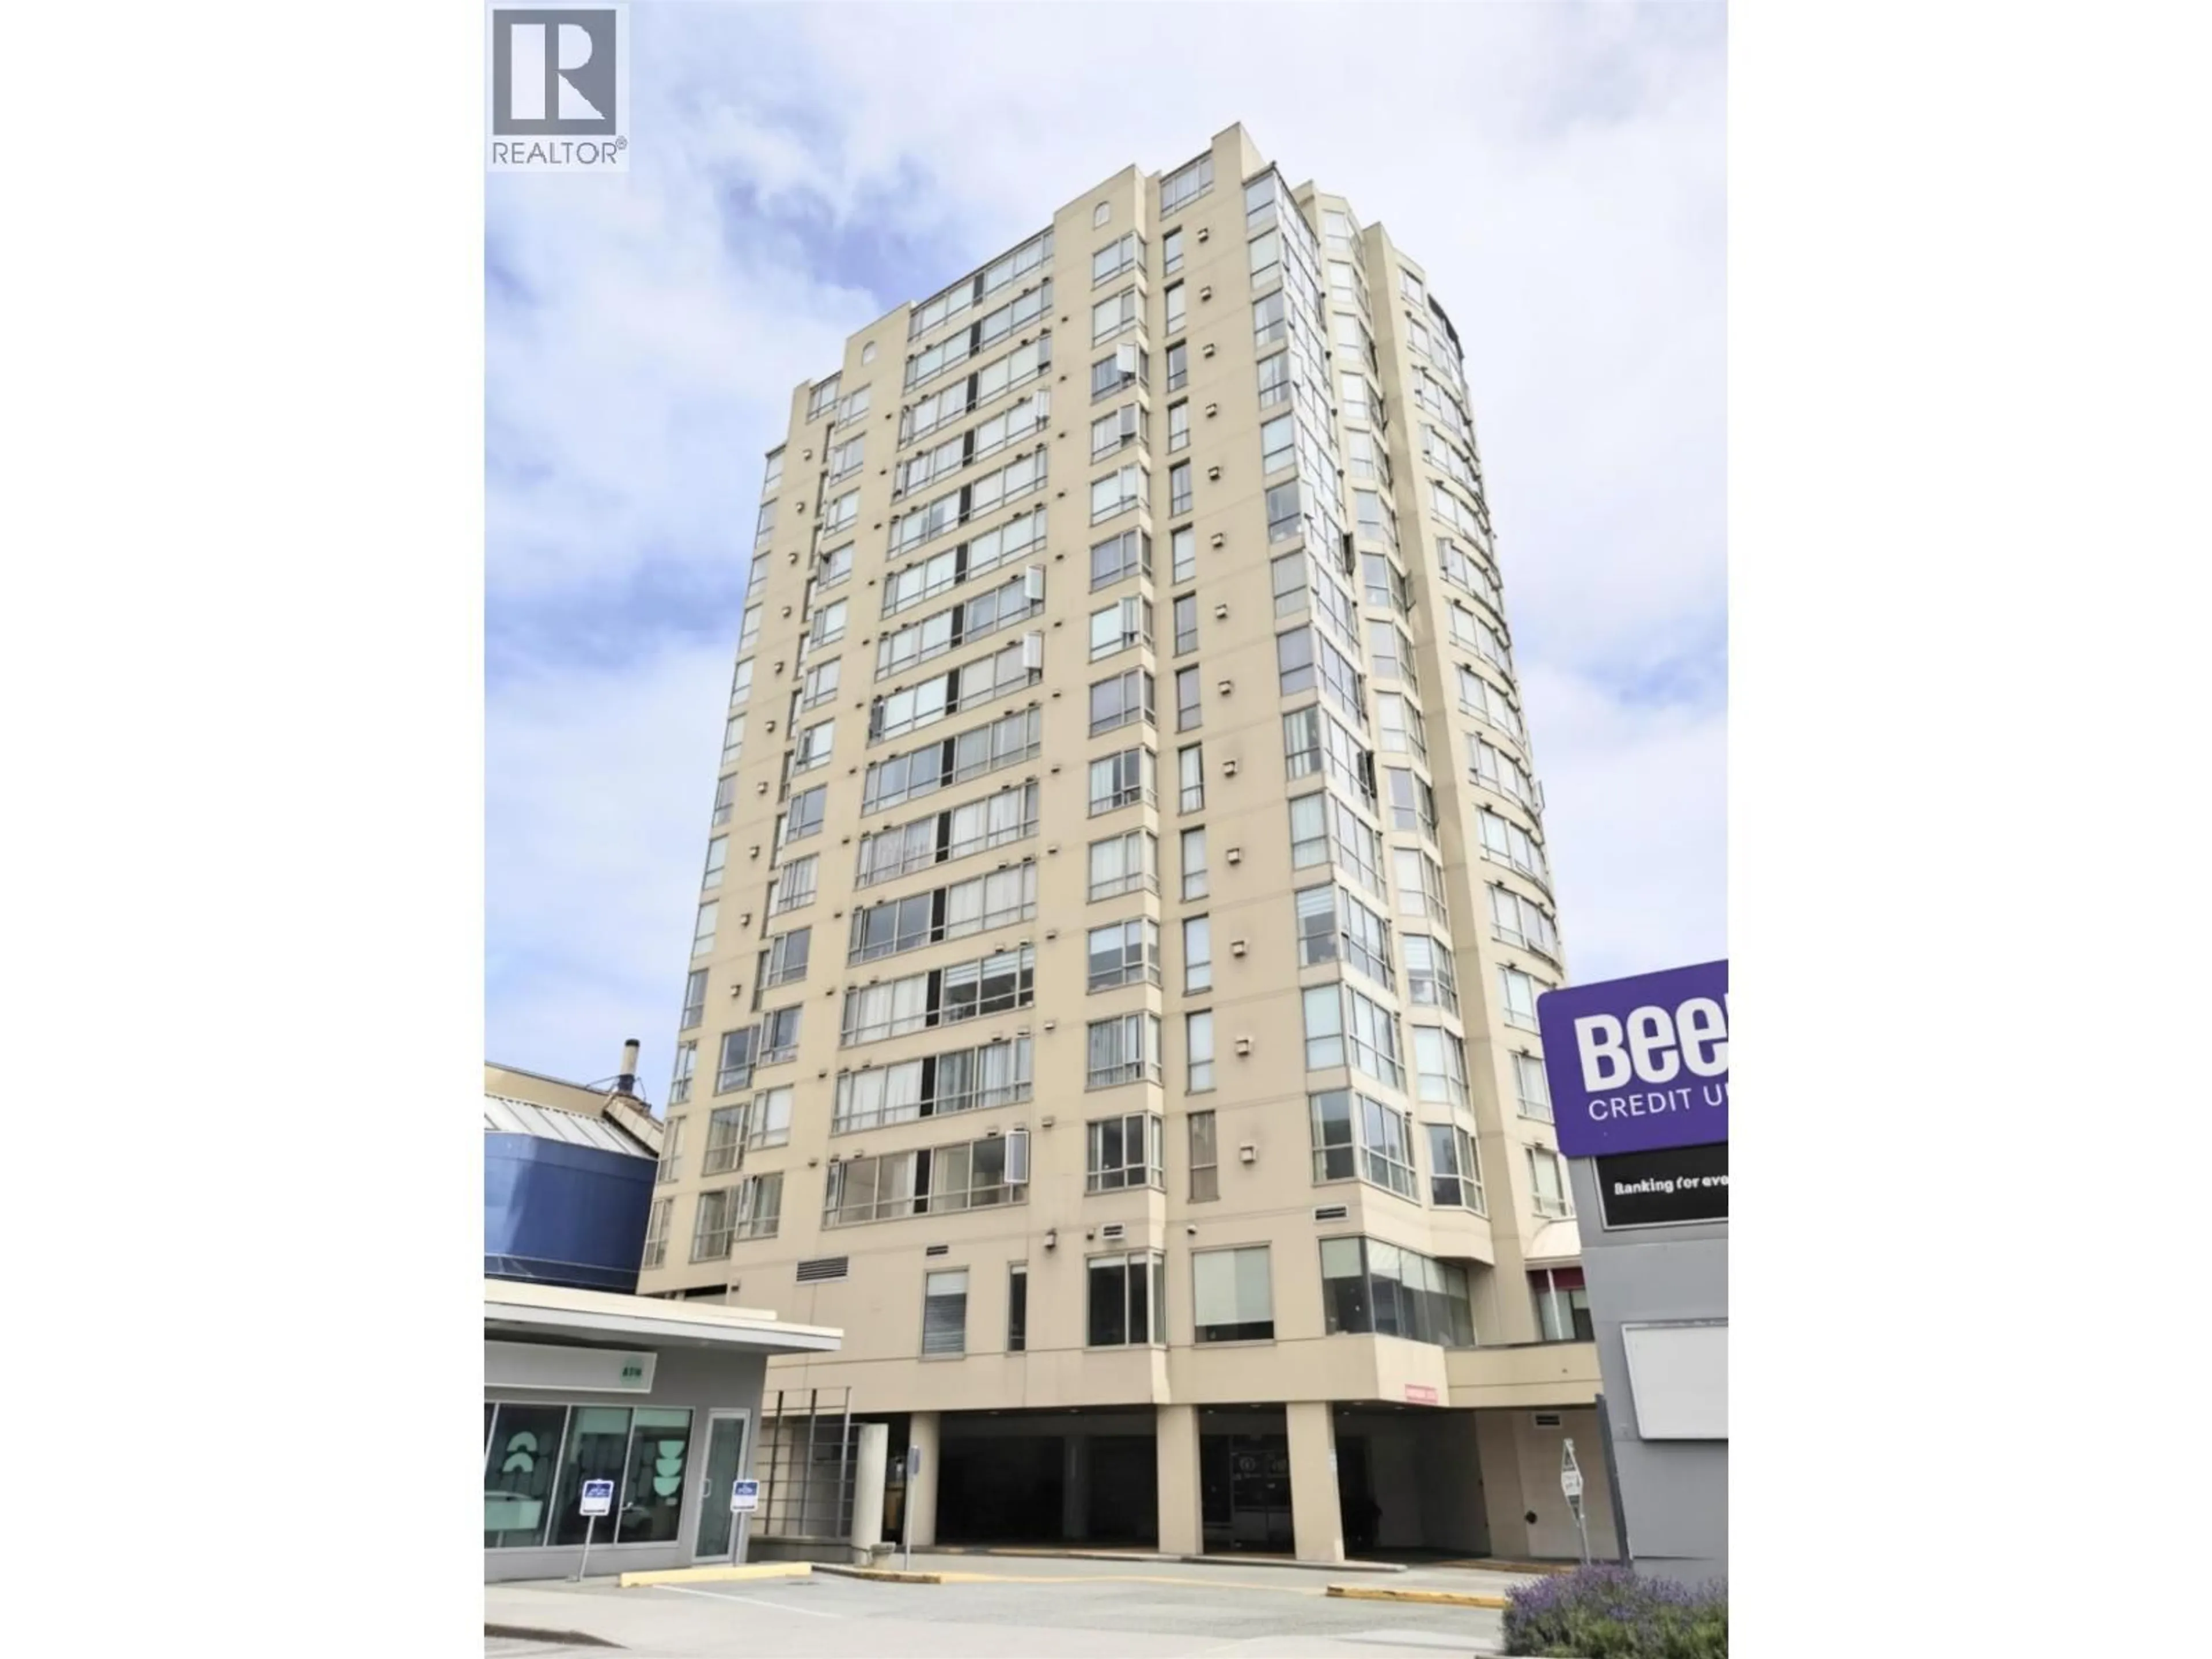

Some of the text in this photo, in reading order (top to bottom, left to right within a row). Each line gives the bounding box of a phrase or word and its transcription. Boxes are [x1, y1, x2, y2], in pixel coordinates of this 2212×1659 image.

[1574, 993, 1728, 1093] Bee
[1589, 1083, 1728, 1121] CREDIT U
[1614, 1177, 1674, 1195] Banking
[1676, 1176, 1699, 1190] for
